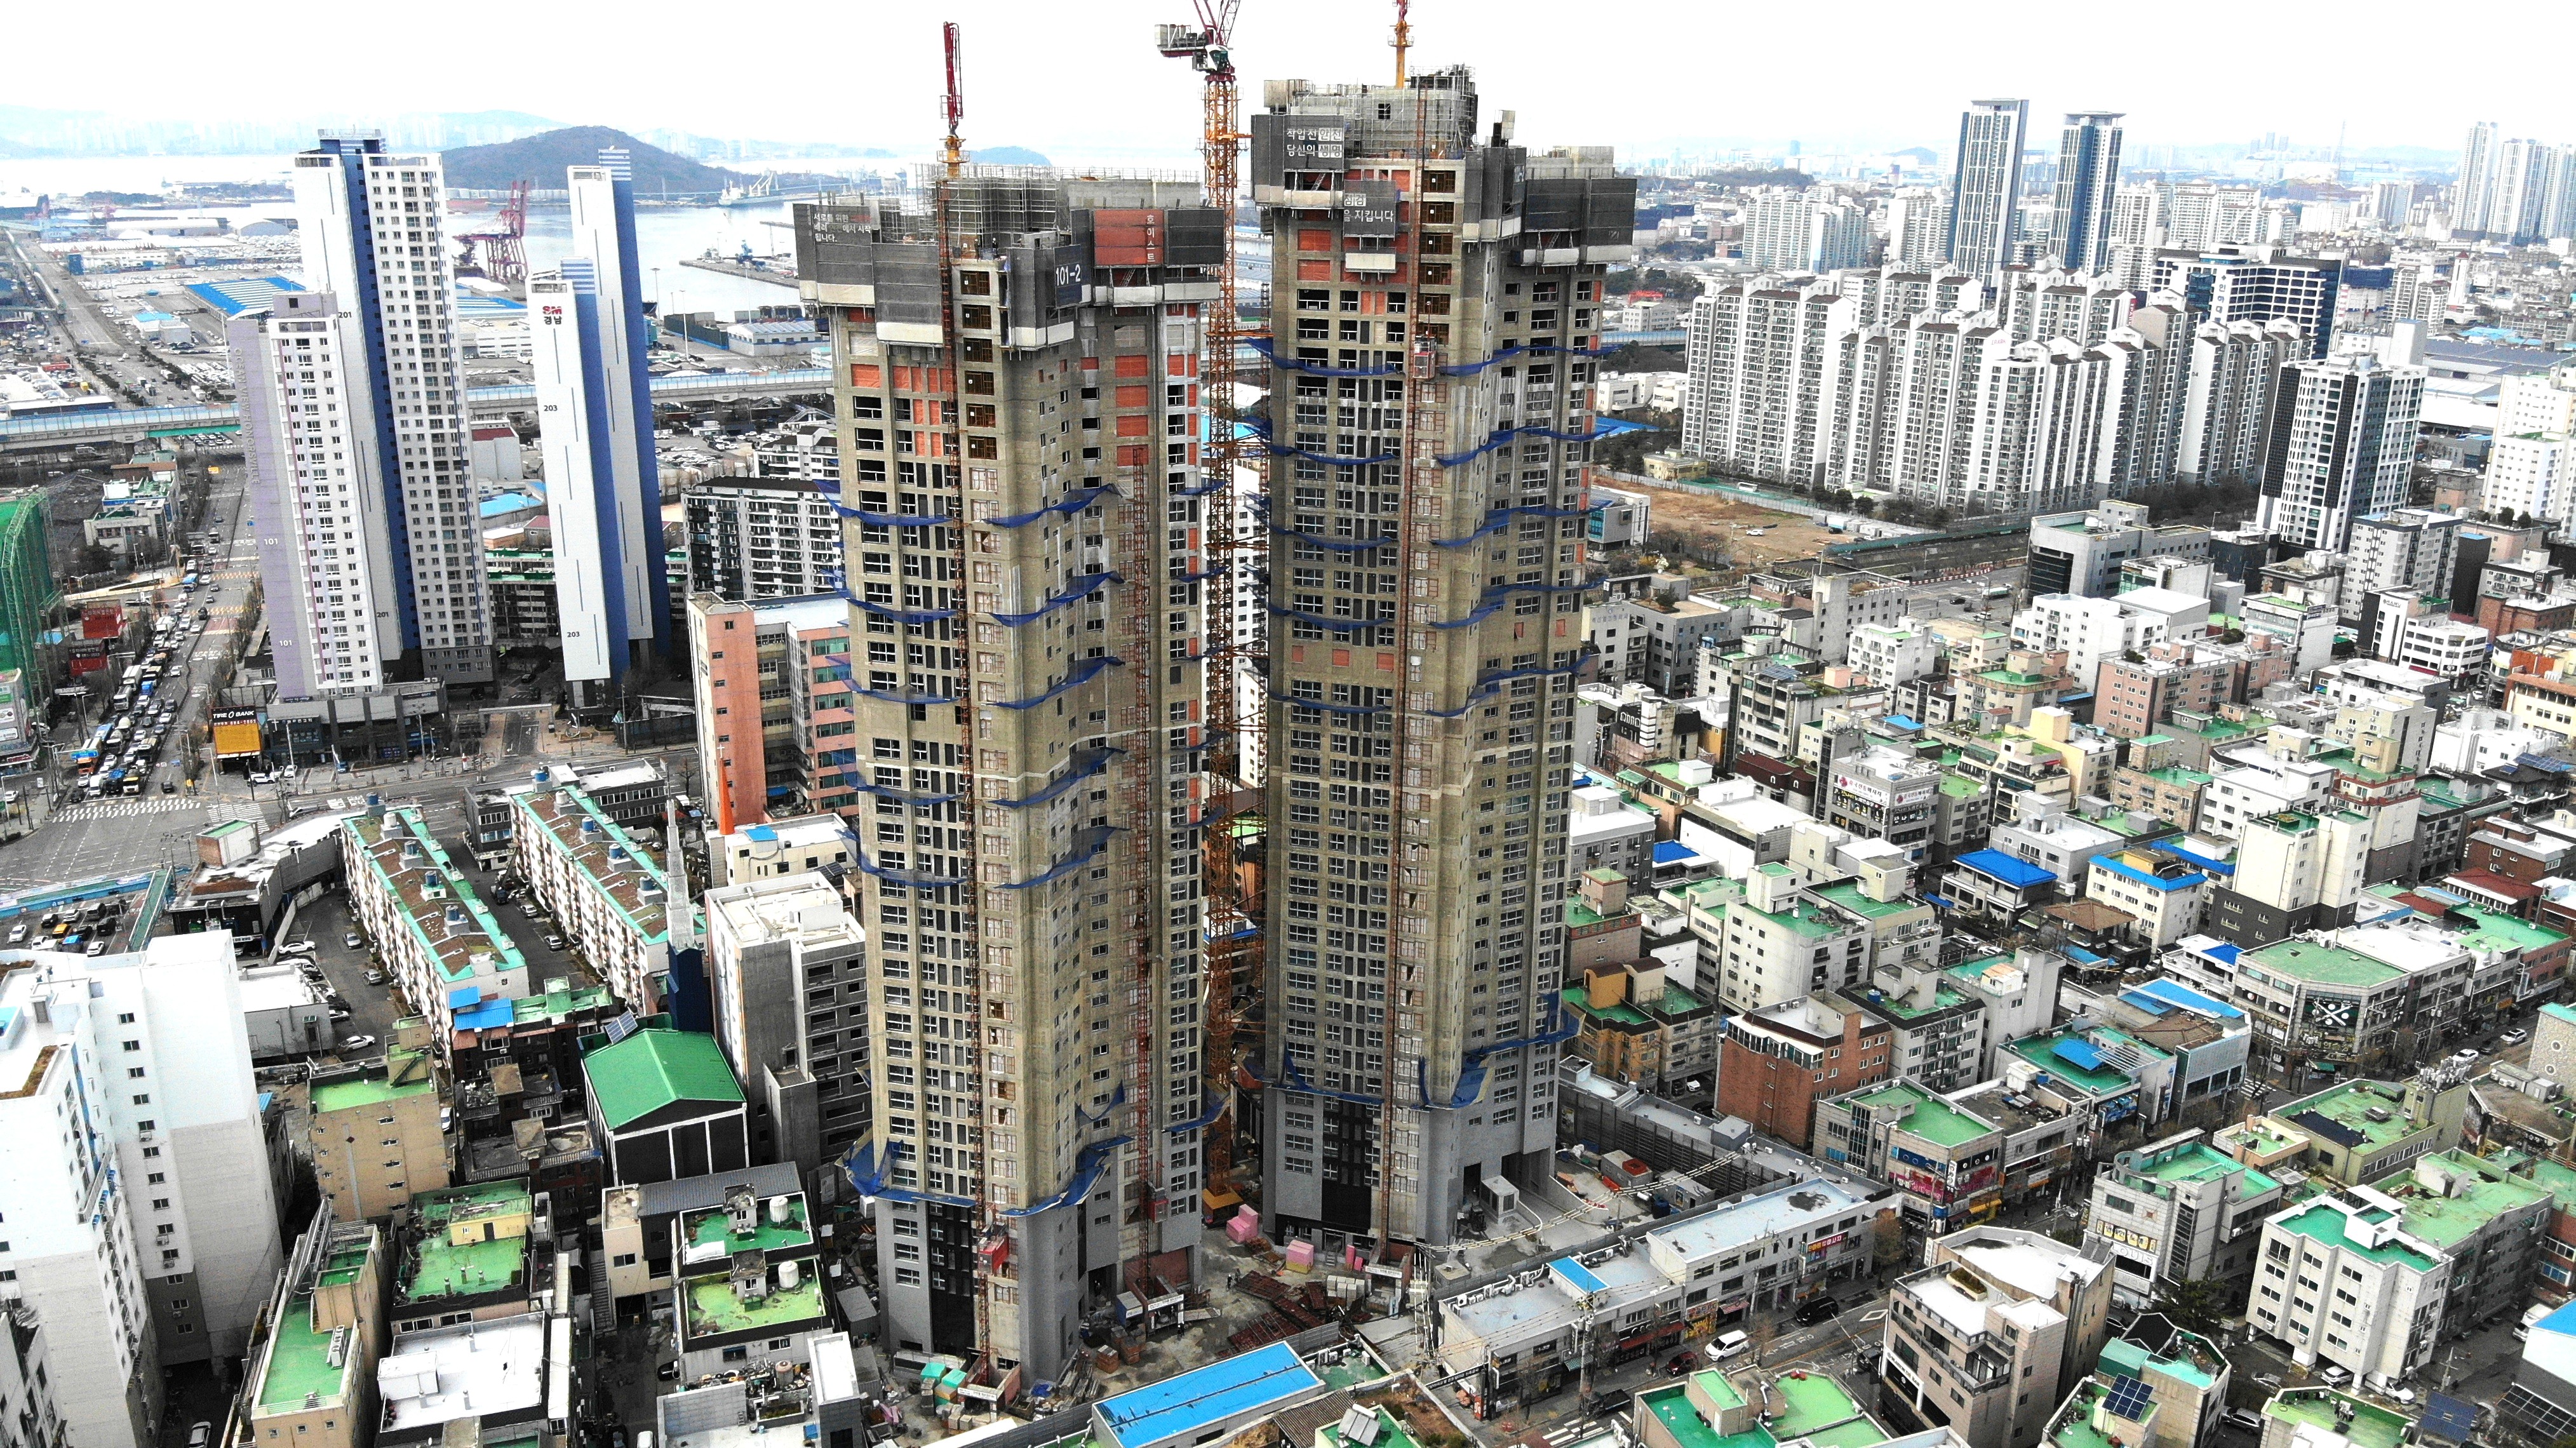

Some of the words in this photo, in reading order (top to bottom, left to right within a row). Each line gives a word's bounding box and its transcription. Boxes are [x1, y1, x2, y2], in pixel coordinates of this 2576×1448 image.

[1287, 144, 1316, 157] 당신의
[1318, 144, 1343, 158] 생명
[1355, 209, 1394, 222] 지킵니다
[1146, 214, 1155, 262] 호이스트
[1056, 264, 1080, 286] 101-2
[542, 305, 562, 314] SM
[544, 316, 562, 325] 경남
[234, 348, 246, 382] OCEAN
[239, 387, 250, 410] VIEW
[243, 414, 260, 485] HONORSVILLE
